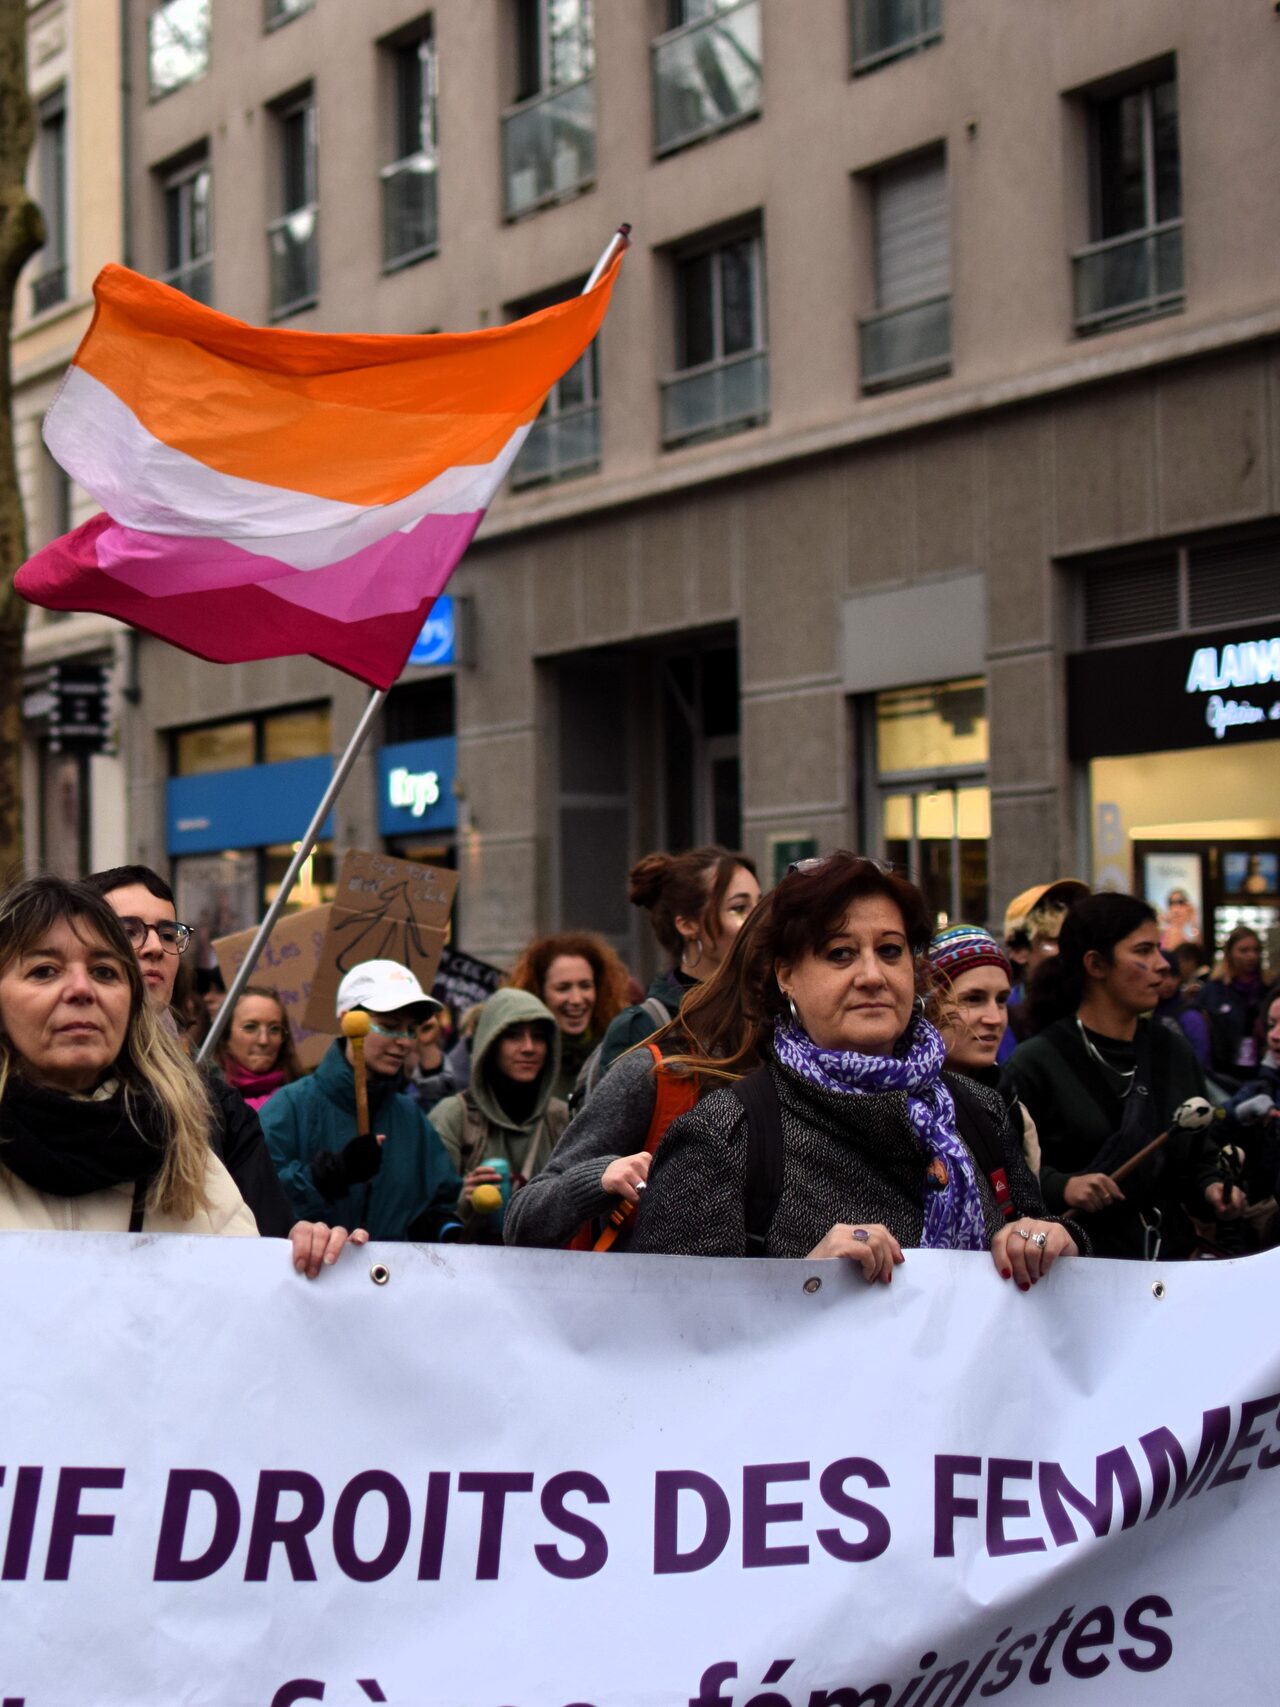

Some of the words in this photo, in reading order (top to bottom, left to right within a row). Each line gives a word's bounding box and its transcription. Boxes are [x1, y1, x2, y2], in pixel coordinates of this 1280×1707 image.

[389, 766, 440, 817] Krys
[153, 1469, 610, 1582] DROITS
[653, 1456, 892, 1575] DES
